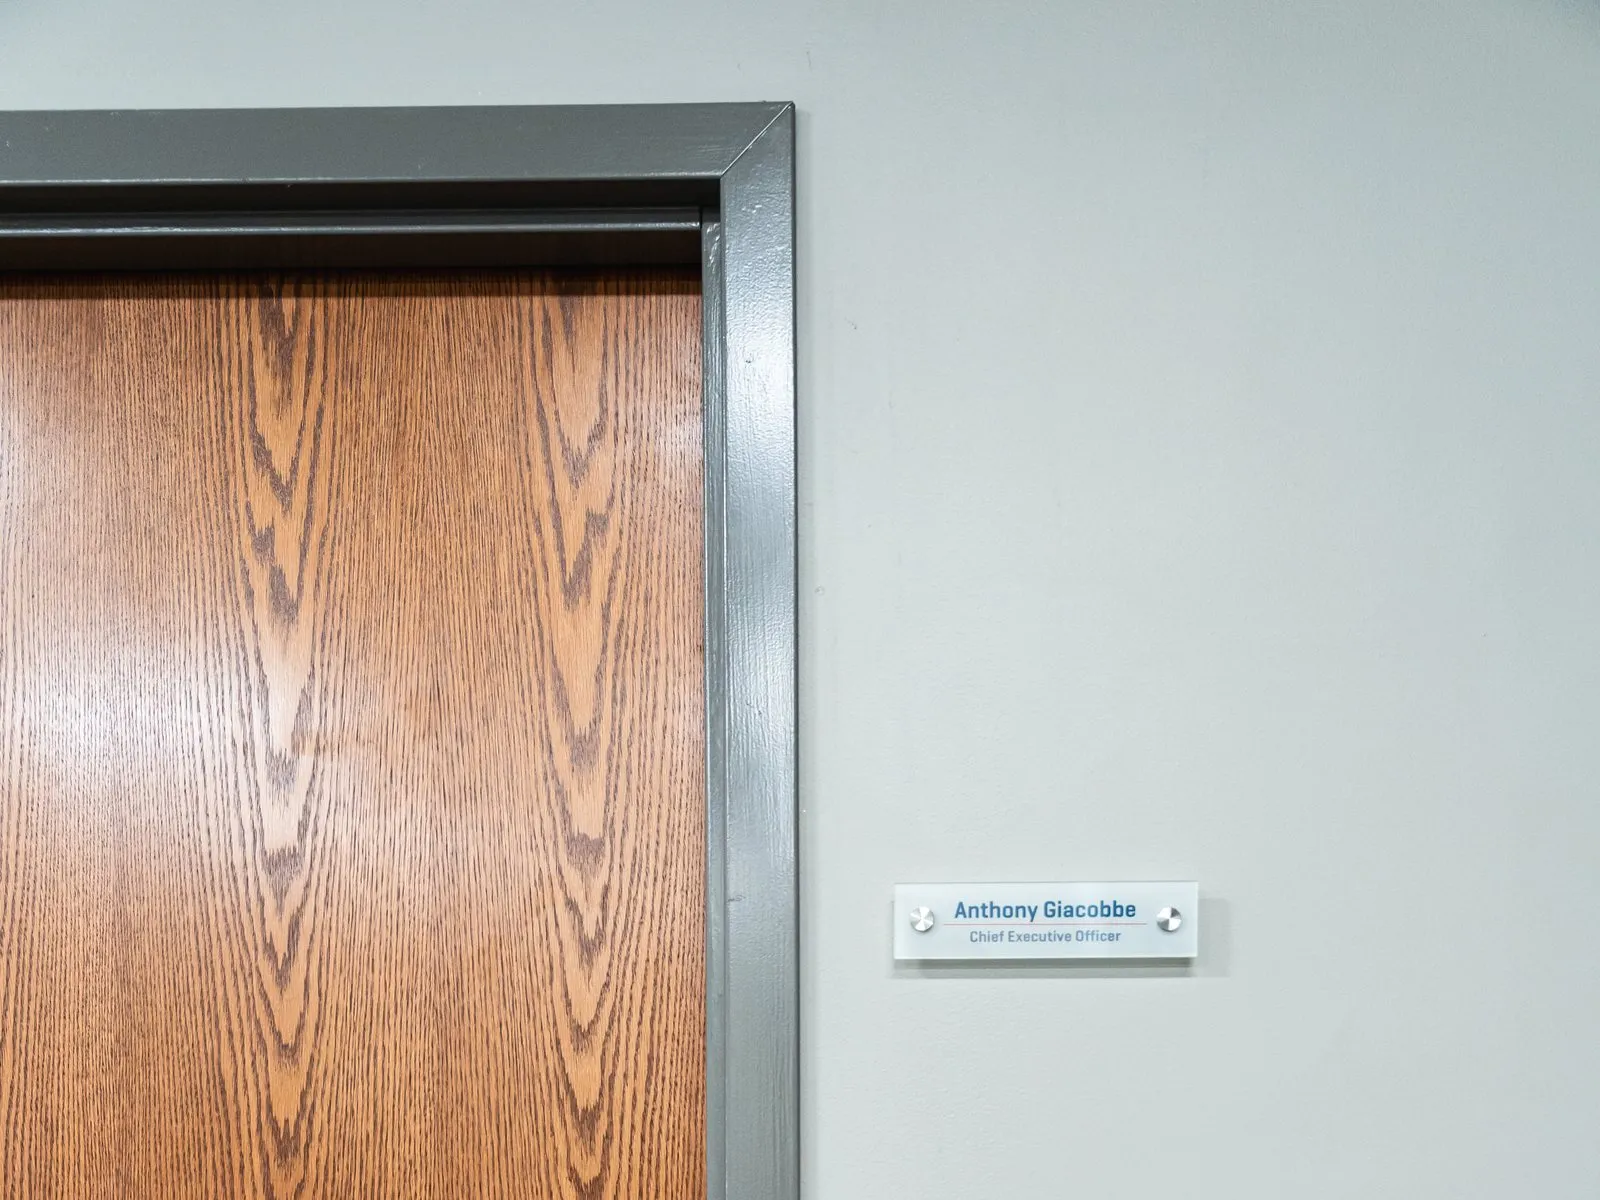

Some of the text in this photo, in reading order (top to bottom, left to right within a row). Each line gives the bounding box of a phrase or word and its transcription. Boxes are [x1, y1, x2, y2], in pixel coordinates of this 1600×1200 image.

[954, 899, 1137, 923] Anthony Giacobbe
[969, 930, 1122, 943] Chief Executive Officer
